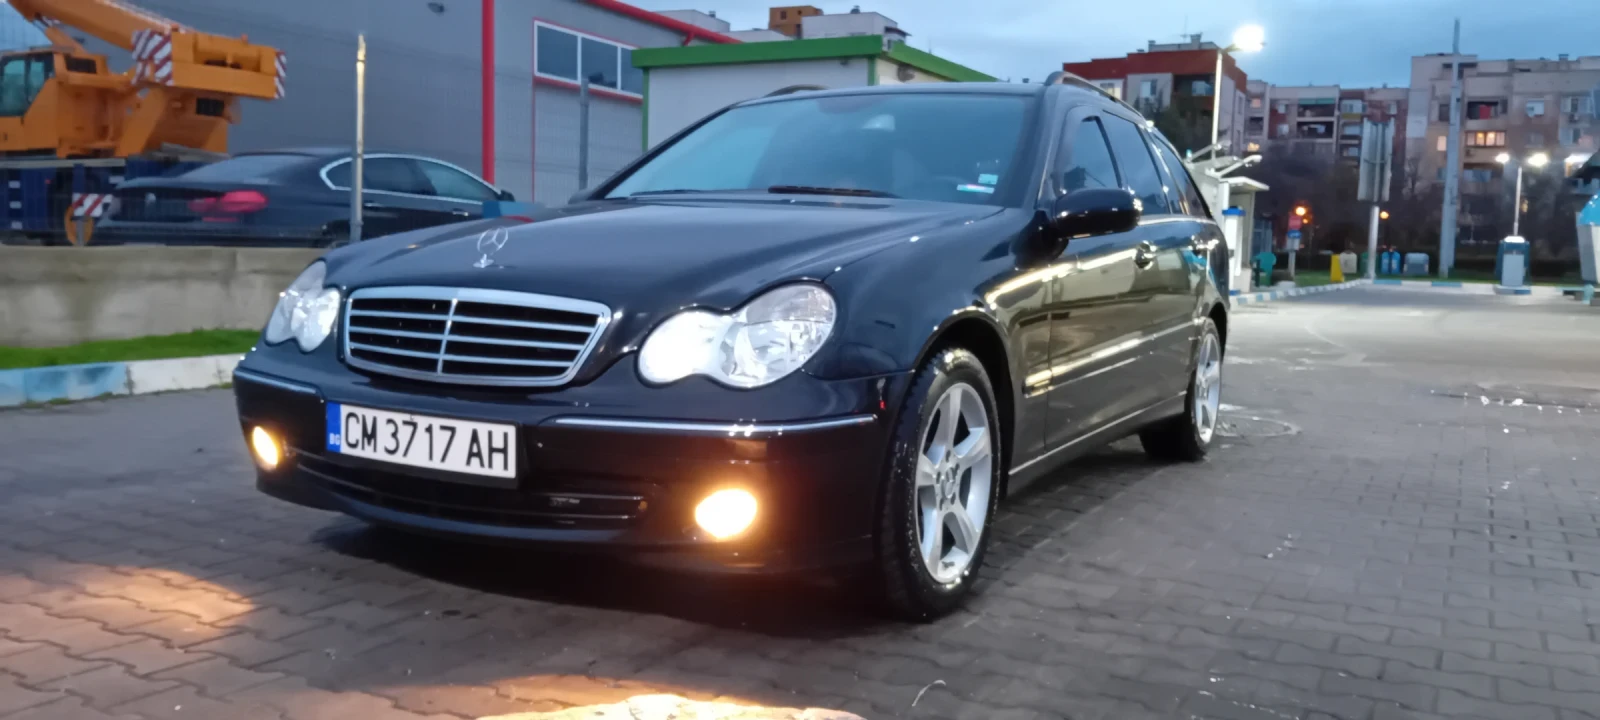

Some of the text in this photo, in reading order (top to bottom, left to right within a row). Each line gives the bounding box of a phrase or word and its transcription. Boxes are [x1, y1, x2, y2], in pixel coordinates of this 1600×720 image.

[345, 412, 508, 471] CM 3717 AH
